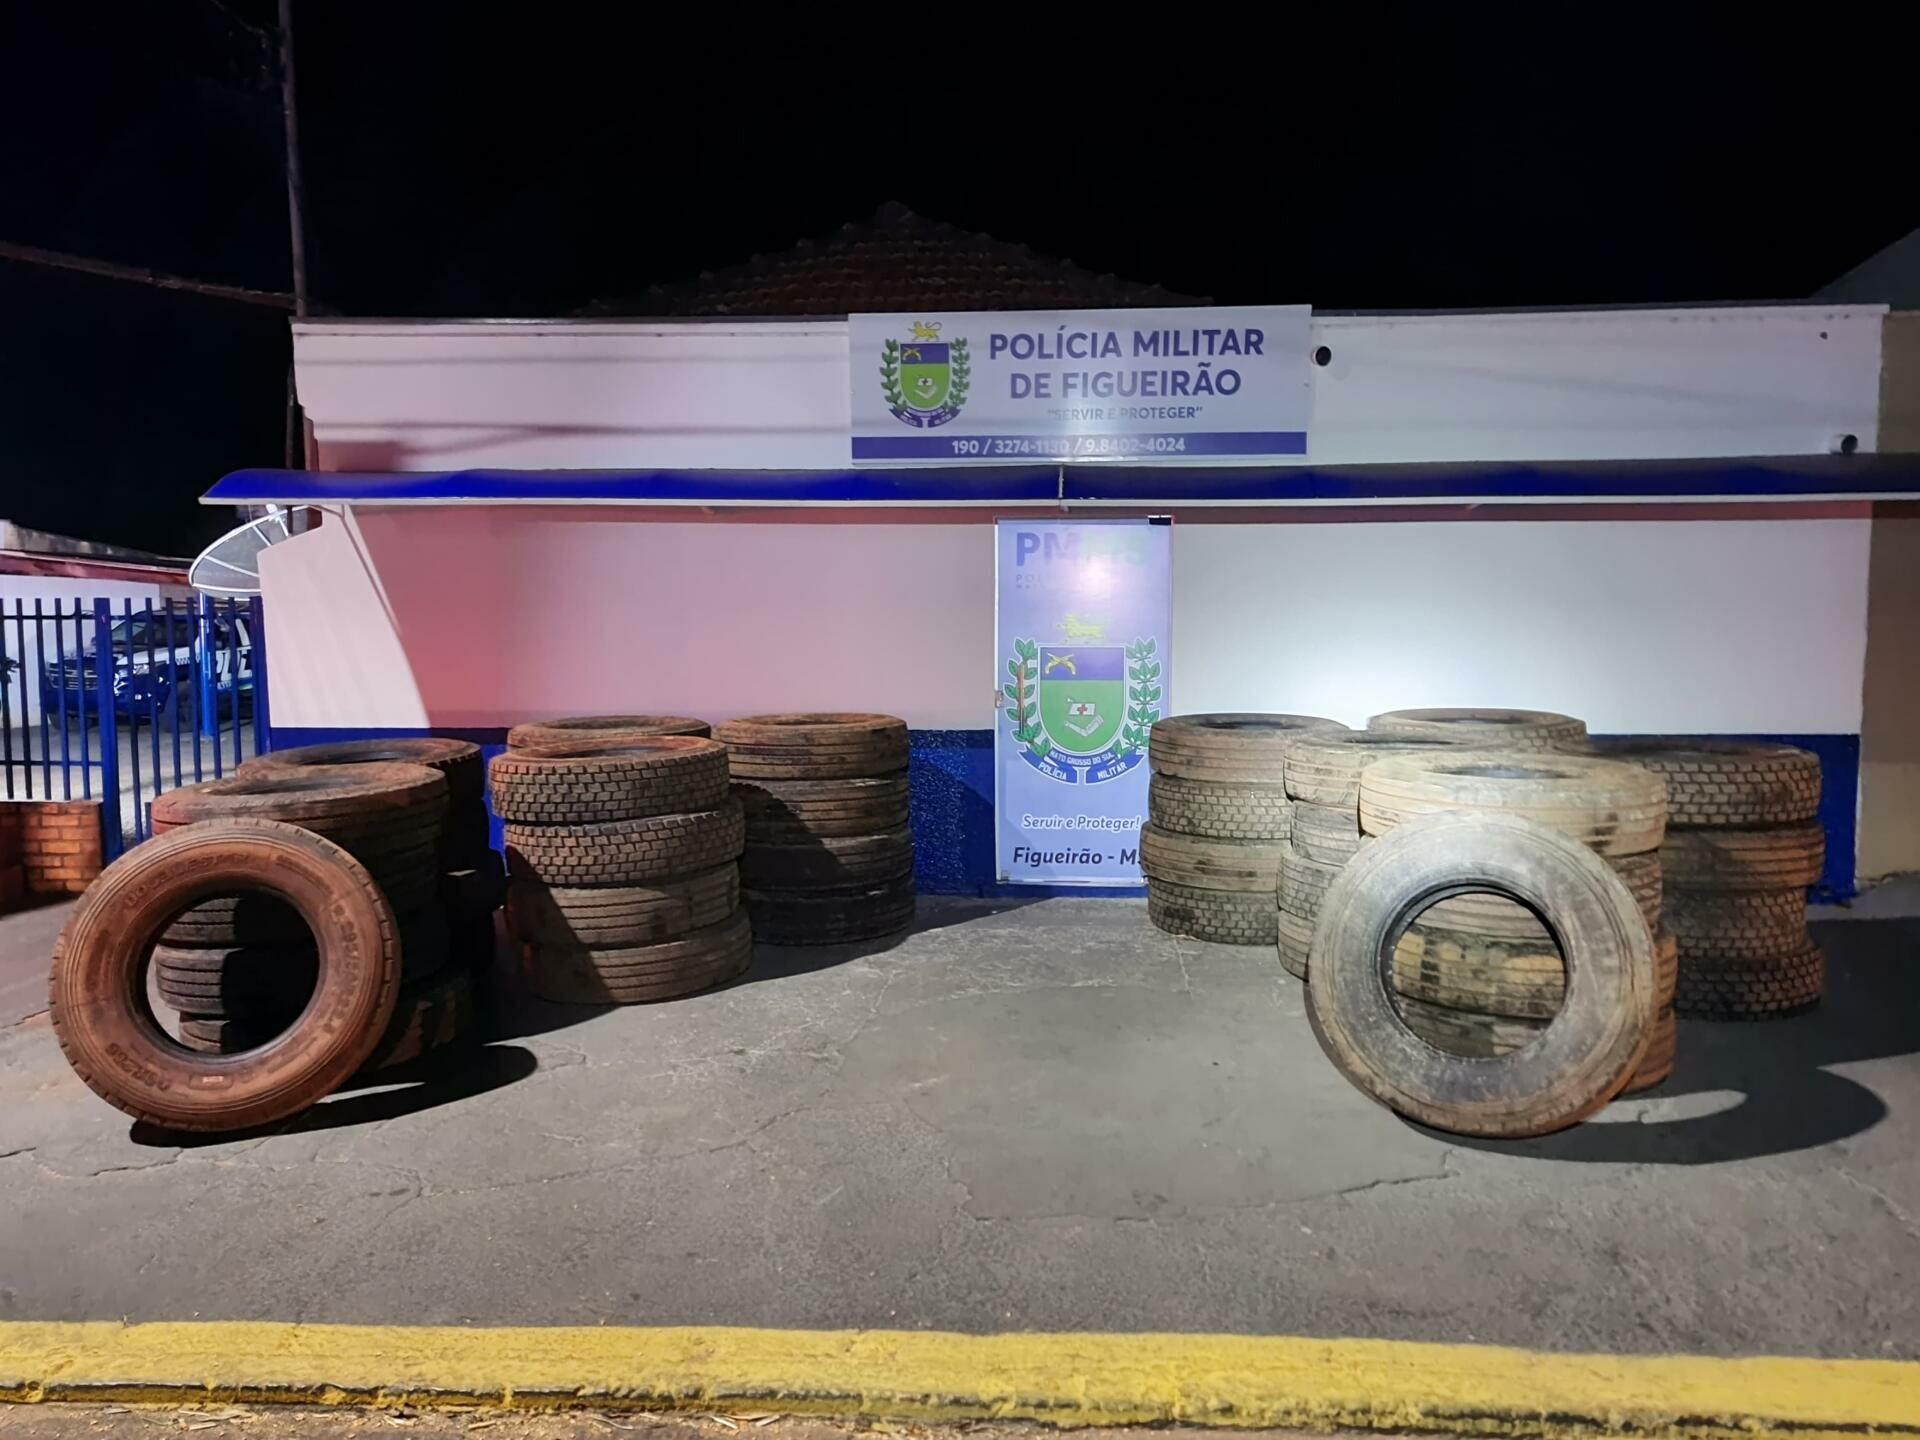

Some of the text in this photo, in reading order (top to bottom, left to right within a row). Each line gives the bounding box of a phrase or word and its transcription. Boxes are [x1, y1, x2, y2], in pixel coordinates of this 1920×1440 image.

[989, 325, 1265, 360] POLÍCIA MILITAR
[1010, 362, 1242, 399] DE FIGUEIRÃO
[1107, 408, 1116, 420] E
[952, 439, 979, 455] 190
[1049, 749, 1066, 761] MATO
[1038, 761, 1127, 780] POLÍCIA MILITAR
[1023, 815, 1140, 832] Servir e Proteger!
[1013, 847, 1103, 868] Figueirão
[1119, 849, 1141, 866] M
